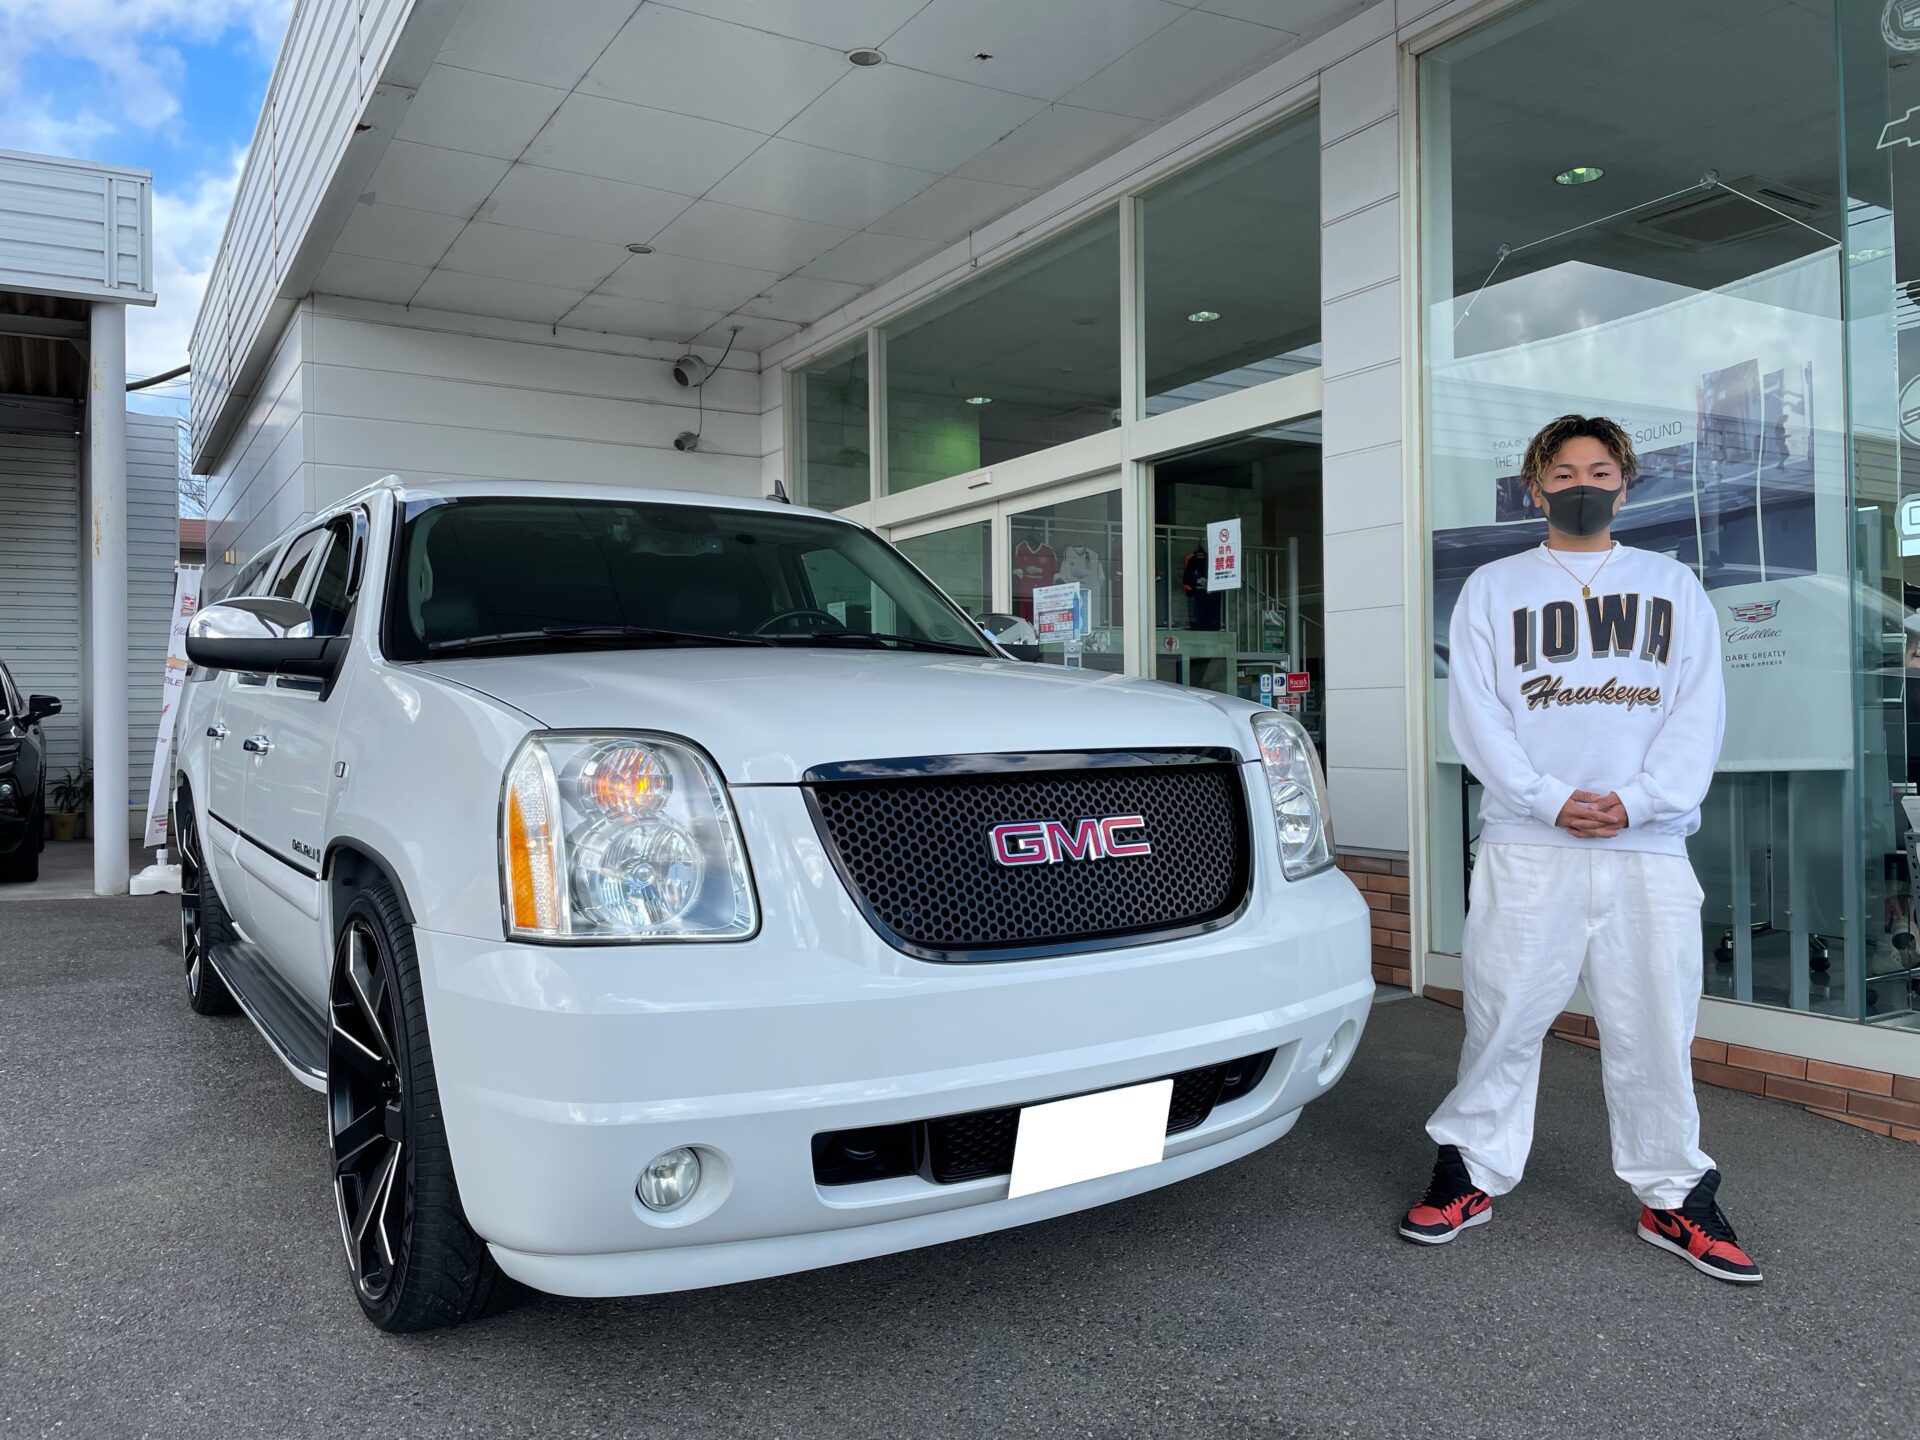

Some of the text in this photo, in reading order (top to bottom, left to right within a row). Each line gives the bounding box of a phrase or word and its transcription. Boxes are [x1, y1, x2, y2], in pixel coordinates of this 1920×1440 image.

[1493, 454, 1513, 470] THE
[1634, 421, 1682, 444] SOUND
[1215, 555, 1235, 571] 禁煙
[1512, 592, 1674, 672] IOWA
[1725, 626, 1782, 644] Cadillac
[1725, 649, 1787, 662] DARE GREATLY
[1520, 674, 1664, 711] Hawkeyes
[989, 815, 1152, 866] GMC
